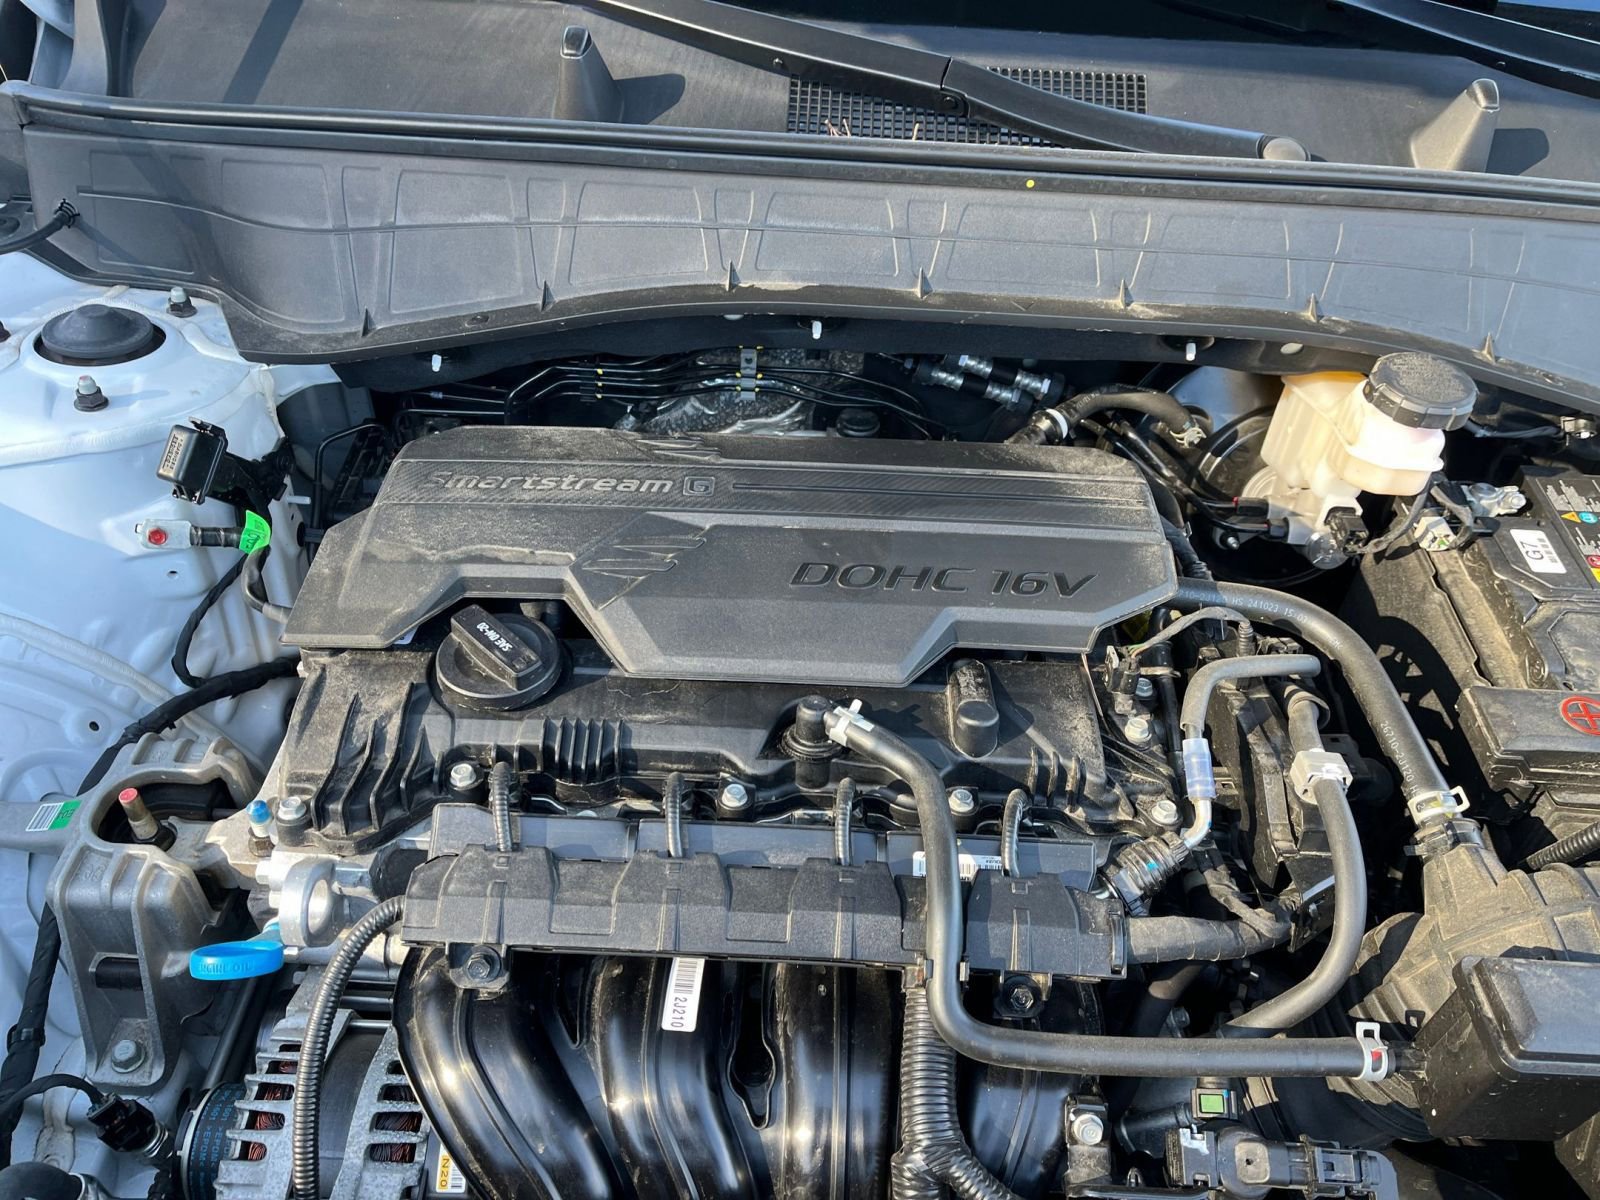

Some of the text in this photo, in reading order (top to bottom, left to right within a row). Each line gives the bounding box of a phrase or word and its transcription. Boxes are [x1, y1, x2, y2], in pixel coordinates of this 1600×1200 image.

[427, 471, 713, 495] Smartstream G
[1520, 540, 1545, 561] G7
[789, 562, 1098, 598] DOHC 16V
[1247, 599, 1279, 613] 241023
[476, 622, 513, 652] SAE 0W-20
[1380, 721, 1415, 781] 26710-2J120
[670, 996, 688, 1028] 2J210
[439, 1157, 450, 1188] N20
